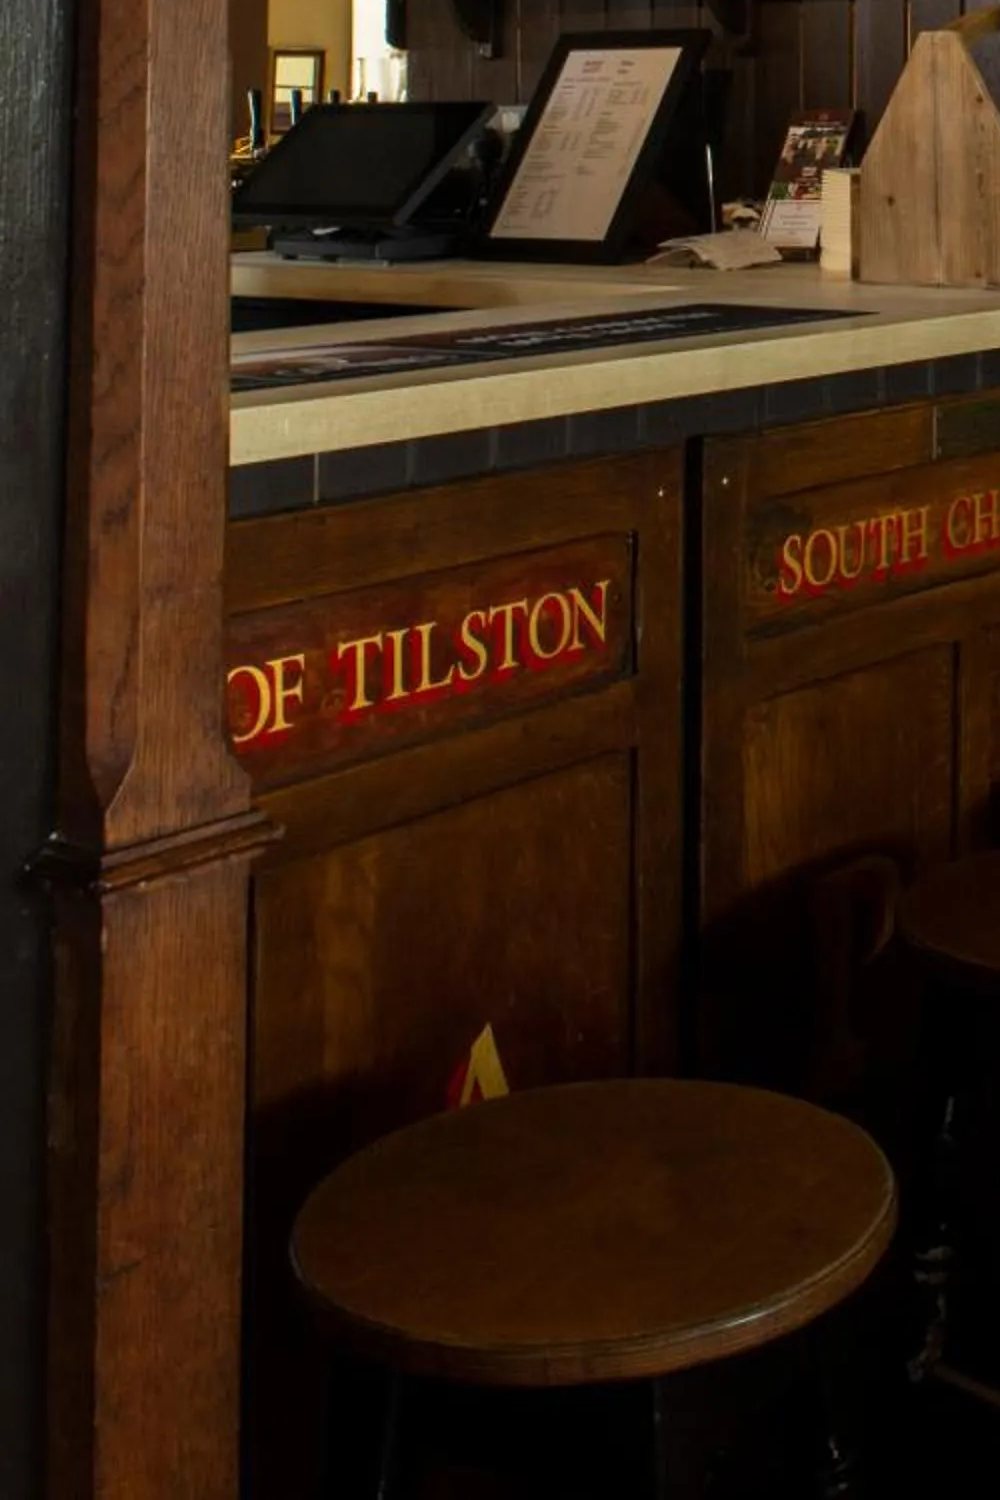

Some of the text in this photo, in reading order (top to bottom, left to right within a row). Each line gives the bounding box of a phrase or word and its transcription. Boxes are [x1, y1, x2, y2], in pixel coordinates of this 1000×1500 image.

[777, 504, 932, 596] SOUTH
[227, 580, 612, 745] OF TILSTON
